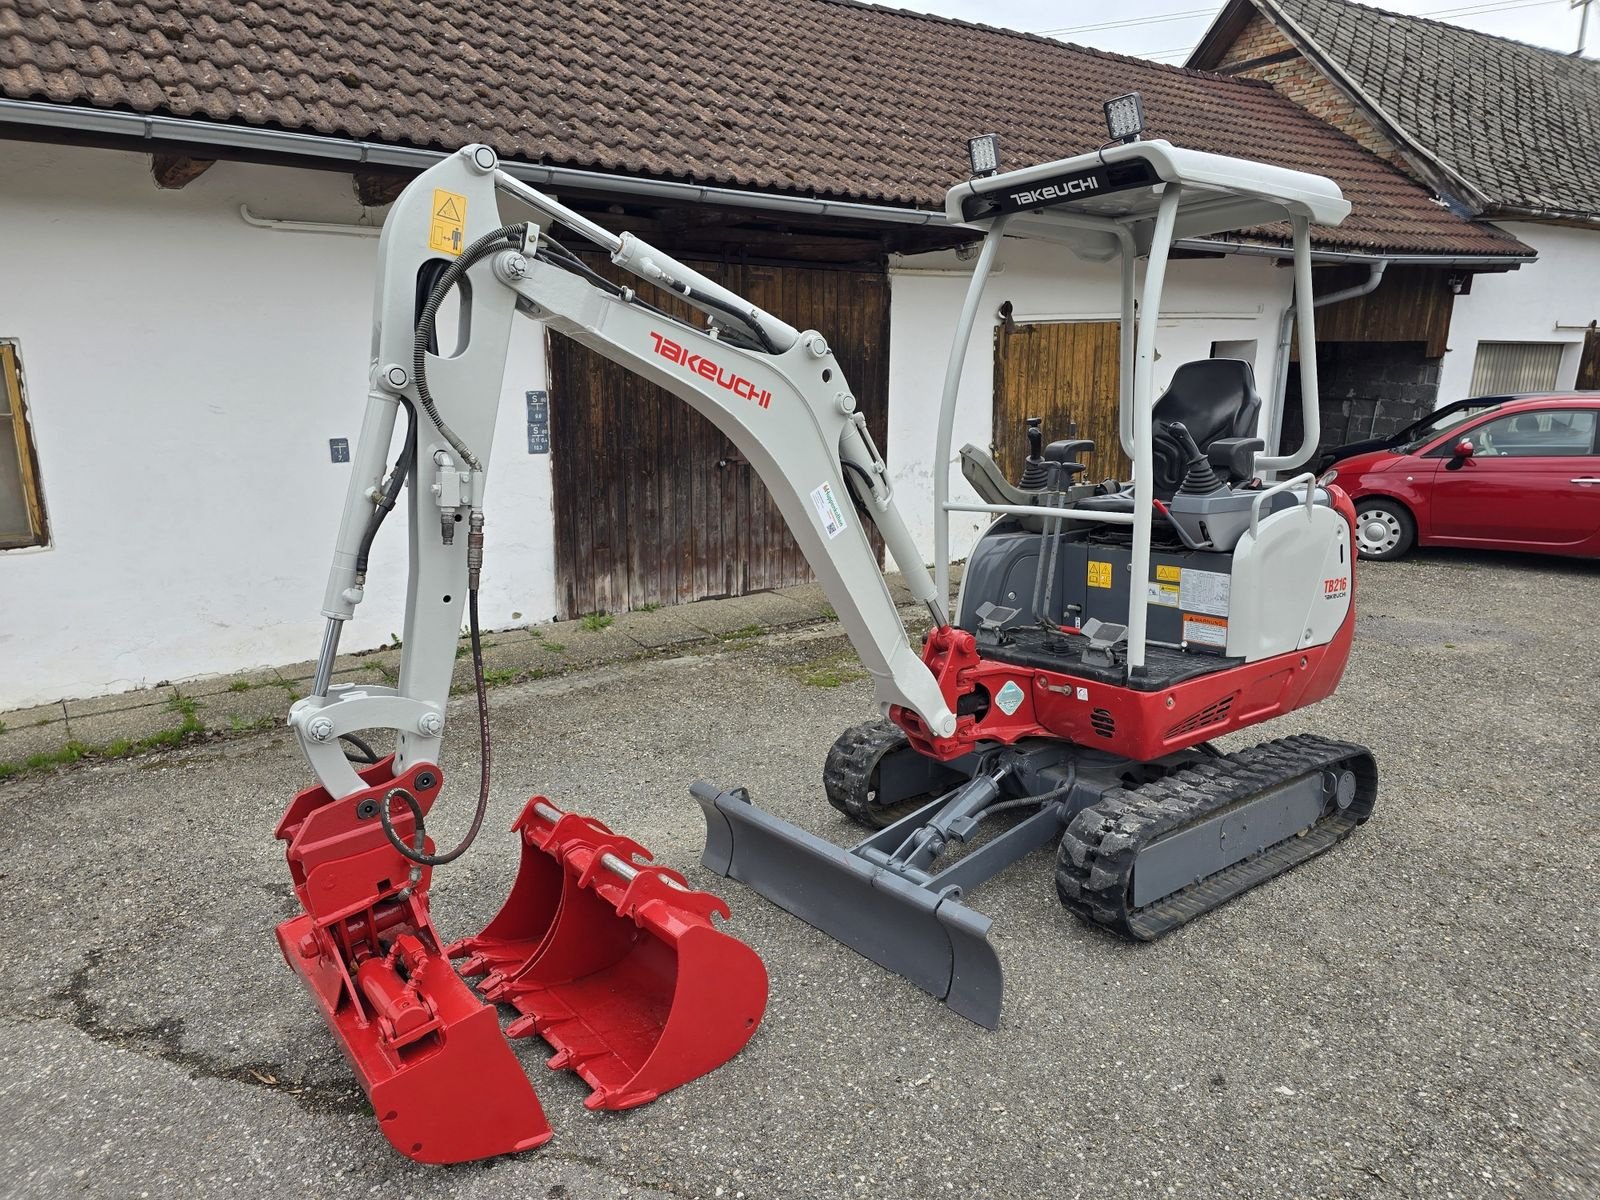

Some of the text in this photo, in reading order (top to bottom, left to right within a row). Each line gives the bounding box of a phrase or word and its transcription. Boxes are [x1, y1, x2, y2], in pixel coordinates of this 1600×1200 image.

[1010, 176, 1099, 206] TAKEUCHI
[650, 331, 772, 409] TAKEUCHI
[1324, 577, 1347, 593] TB216
